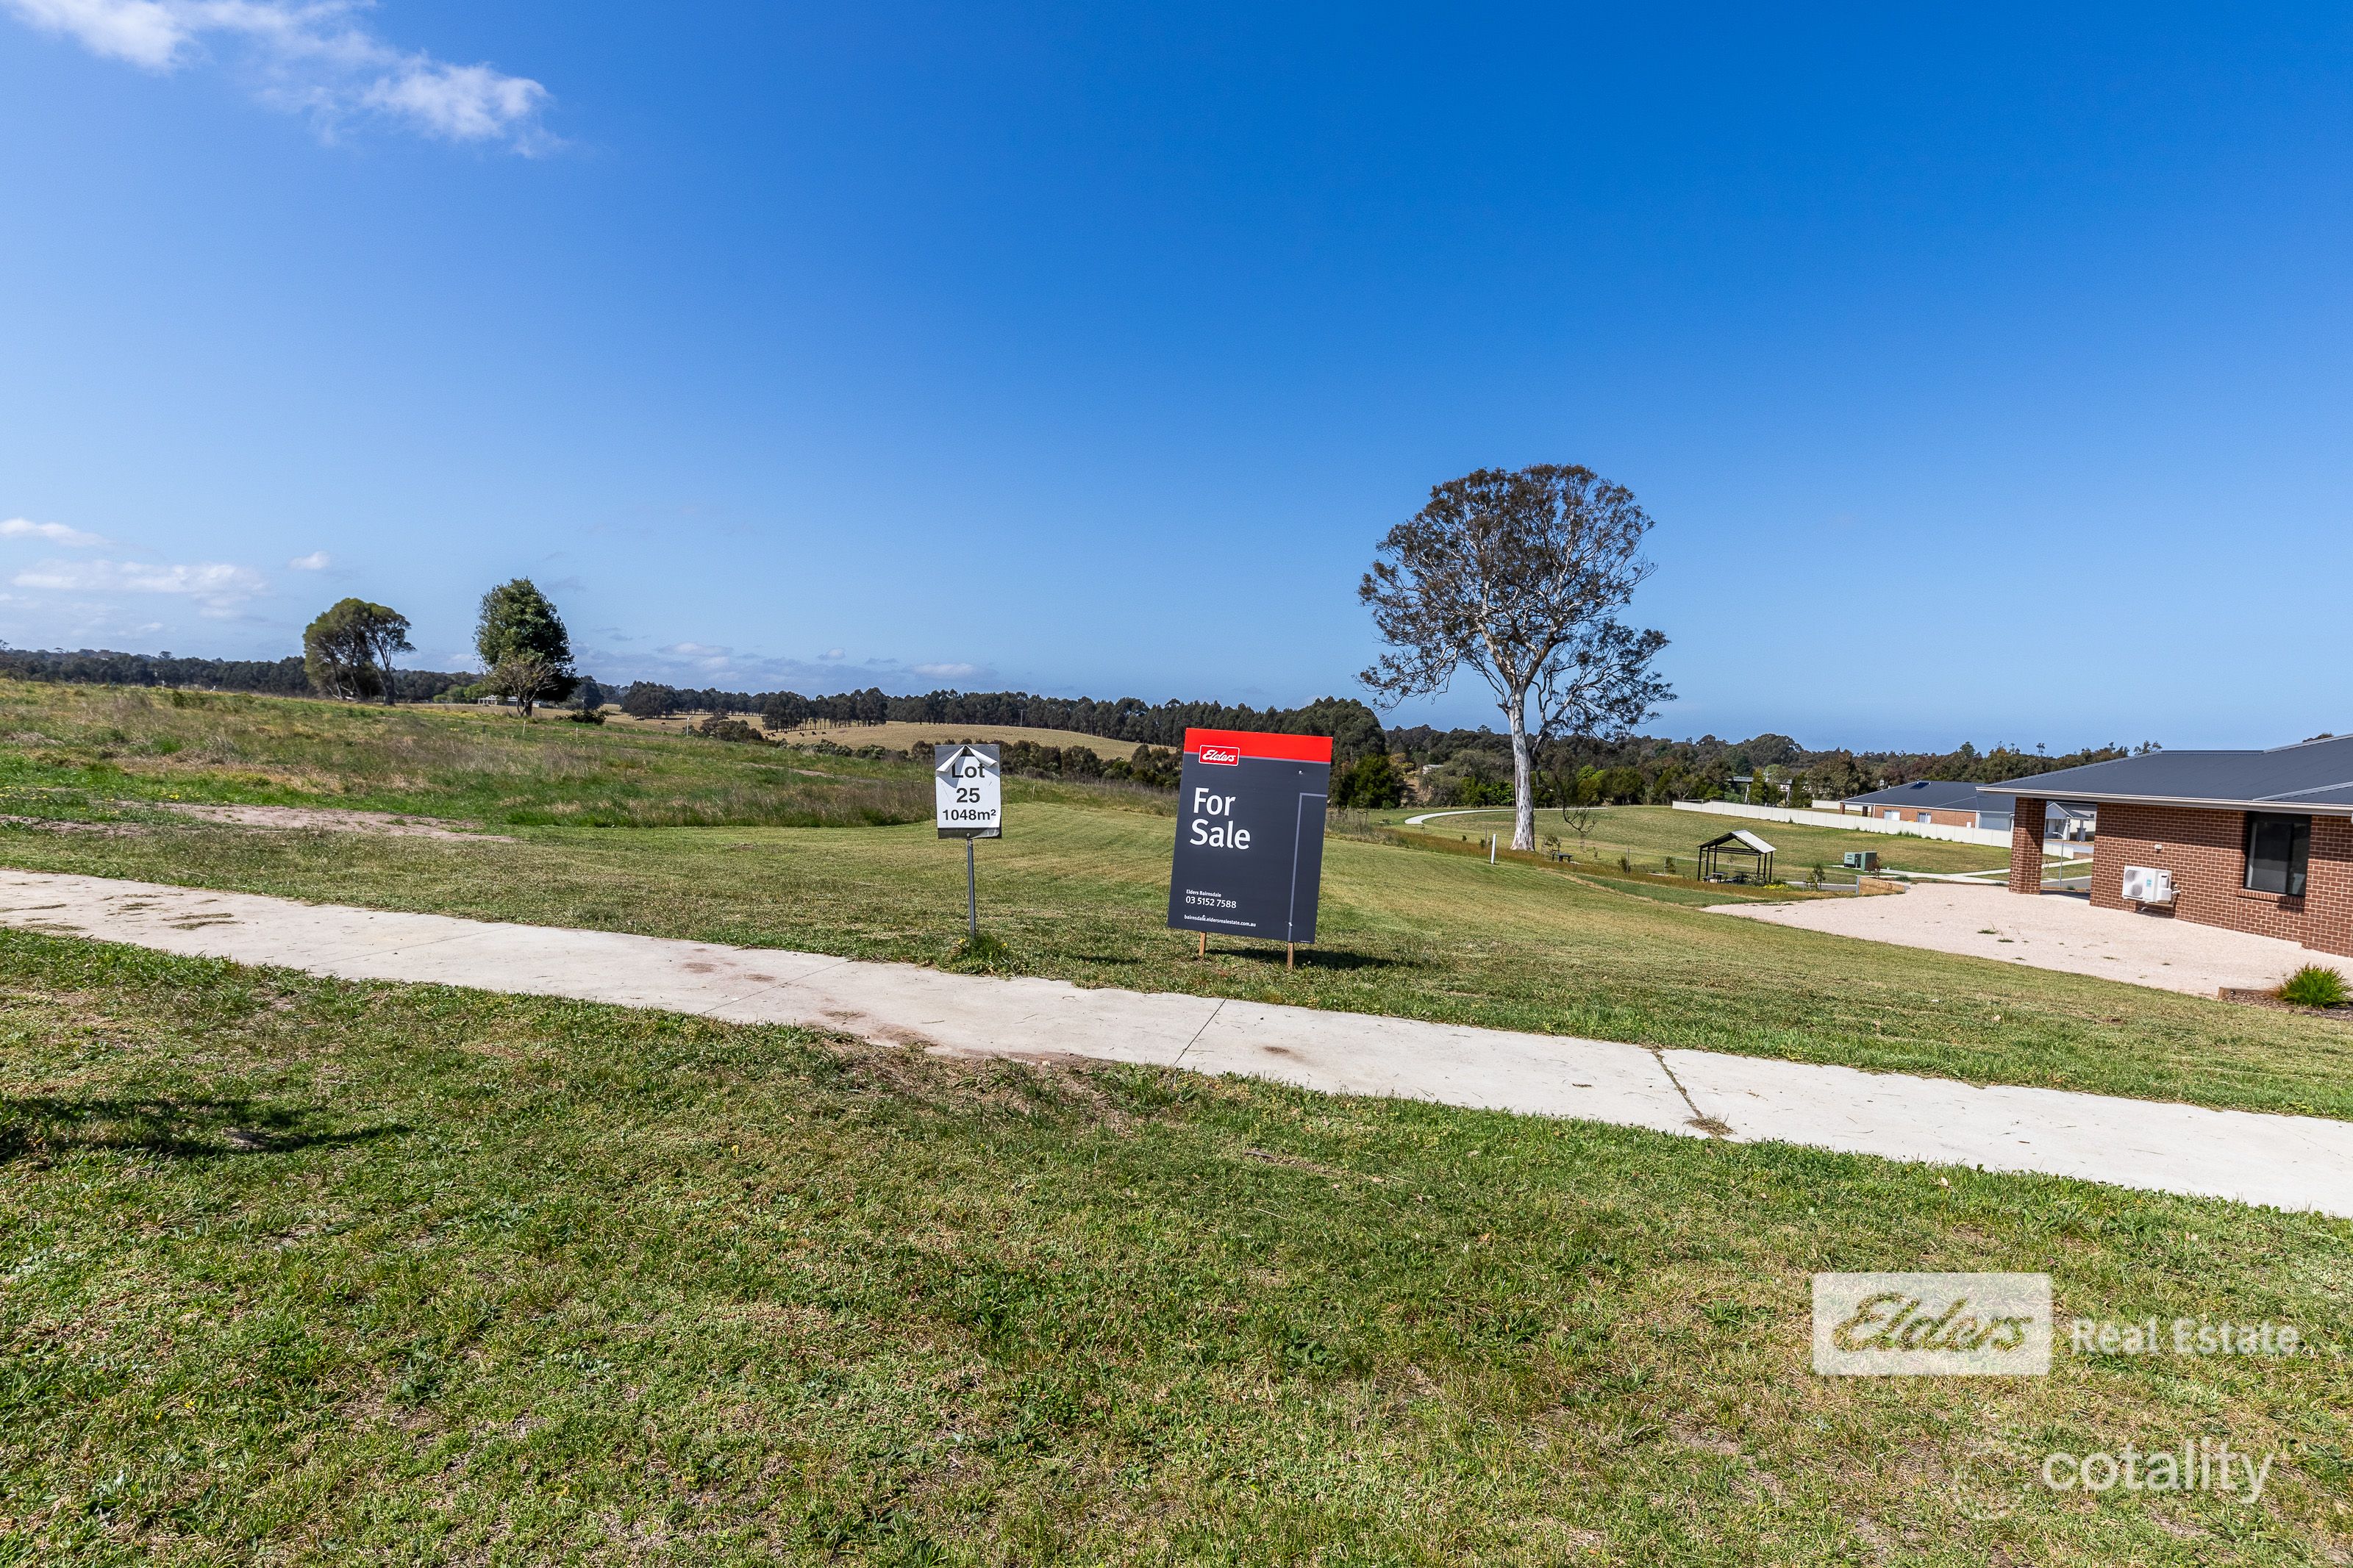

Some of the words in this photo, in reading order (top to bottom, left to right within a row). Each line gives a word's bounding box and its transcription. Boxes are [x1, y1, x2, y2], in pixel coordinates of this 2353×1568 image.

[1202, 749, 1237, 762] Elders
[951, 762, 985, 778] Lot
[956, 787, 980, 803] 25
[1193, 787, 1236, 816] For
[1189, 818, 1251, 850] Sale
[1185, 895, 1196, 904] 03
[1197, 897, 1215, 906] 5152
[1216, 899, 1237, 909] 7588
